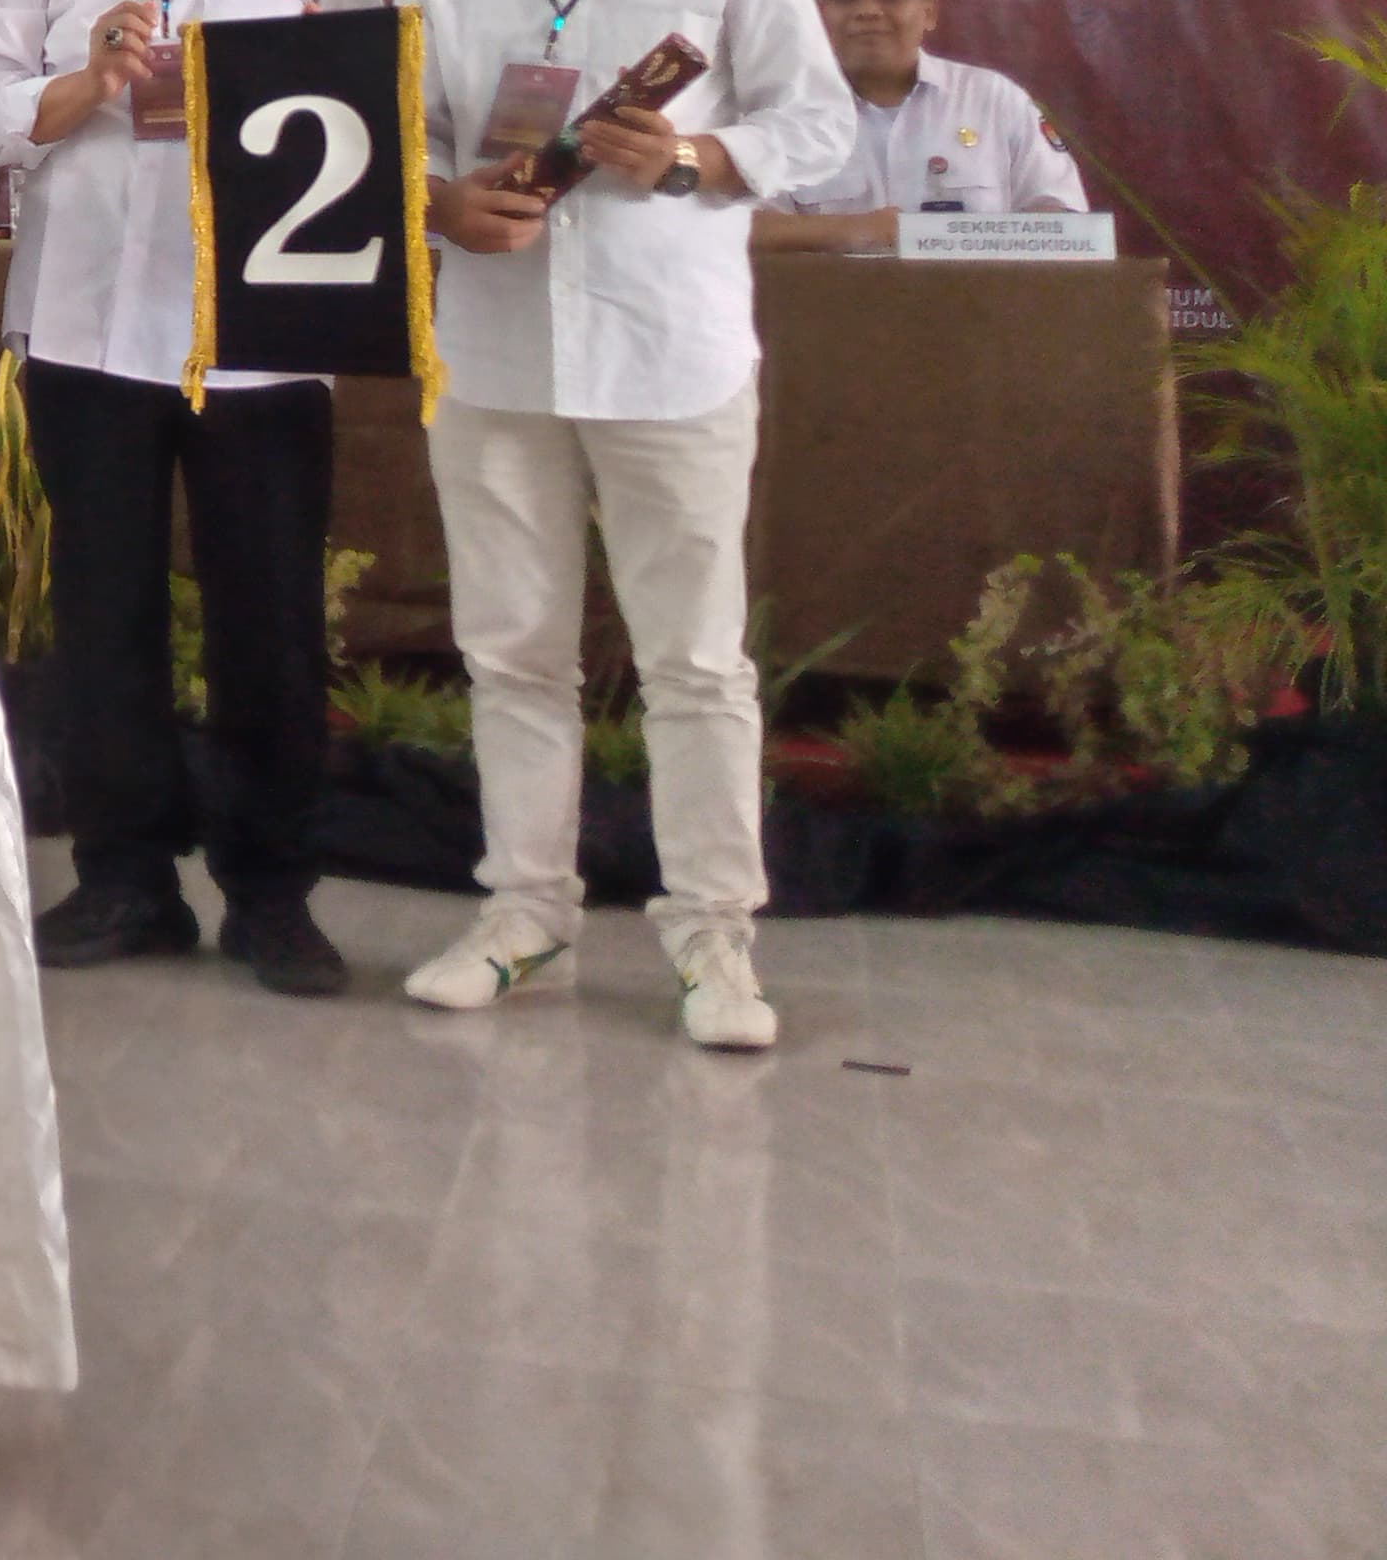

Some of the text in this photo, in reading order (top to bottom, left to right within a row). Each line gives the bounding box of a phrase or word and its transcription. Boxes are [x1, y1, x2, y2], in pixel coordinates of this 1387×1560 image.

[239, 94, 384, 284] 2
[946, 221, 1064, 235] SEKRETARIS
[918, 239, 1097, 252] KPU GUNUNGKIDUL
